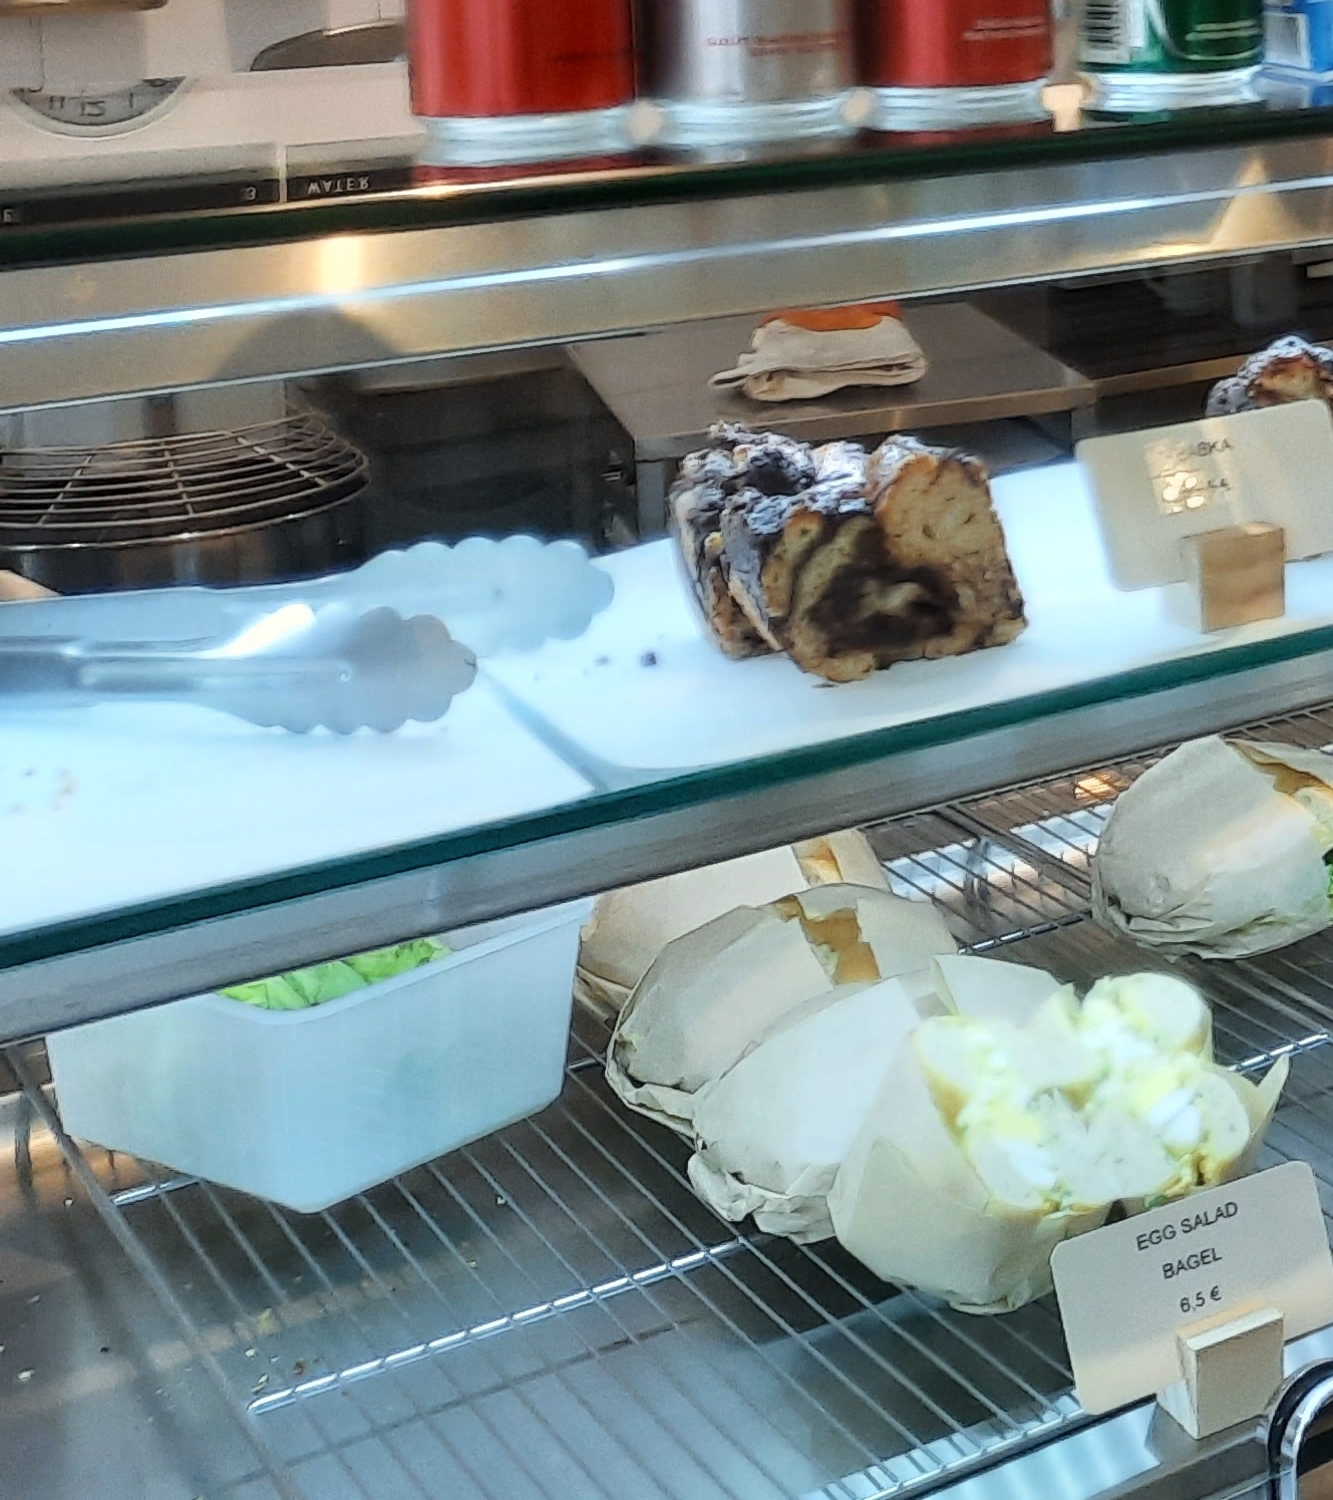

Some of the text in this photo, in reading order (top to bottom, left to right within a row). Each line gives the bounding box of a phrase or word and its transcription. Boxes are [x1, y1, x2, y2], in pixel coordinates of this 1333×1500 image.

[1135, 1200, 1240, 1251] EGG SALAD
[1161, 1247, 1223, 1280] BAGEL
[1210, 1285, 1223, 1302] €
